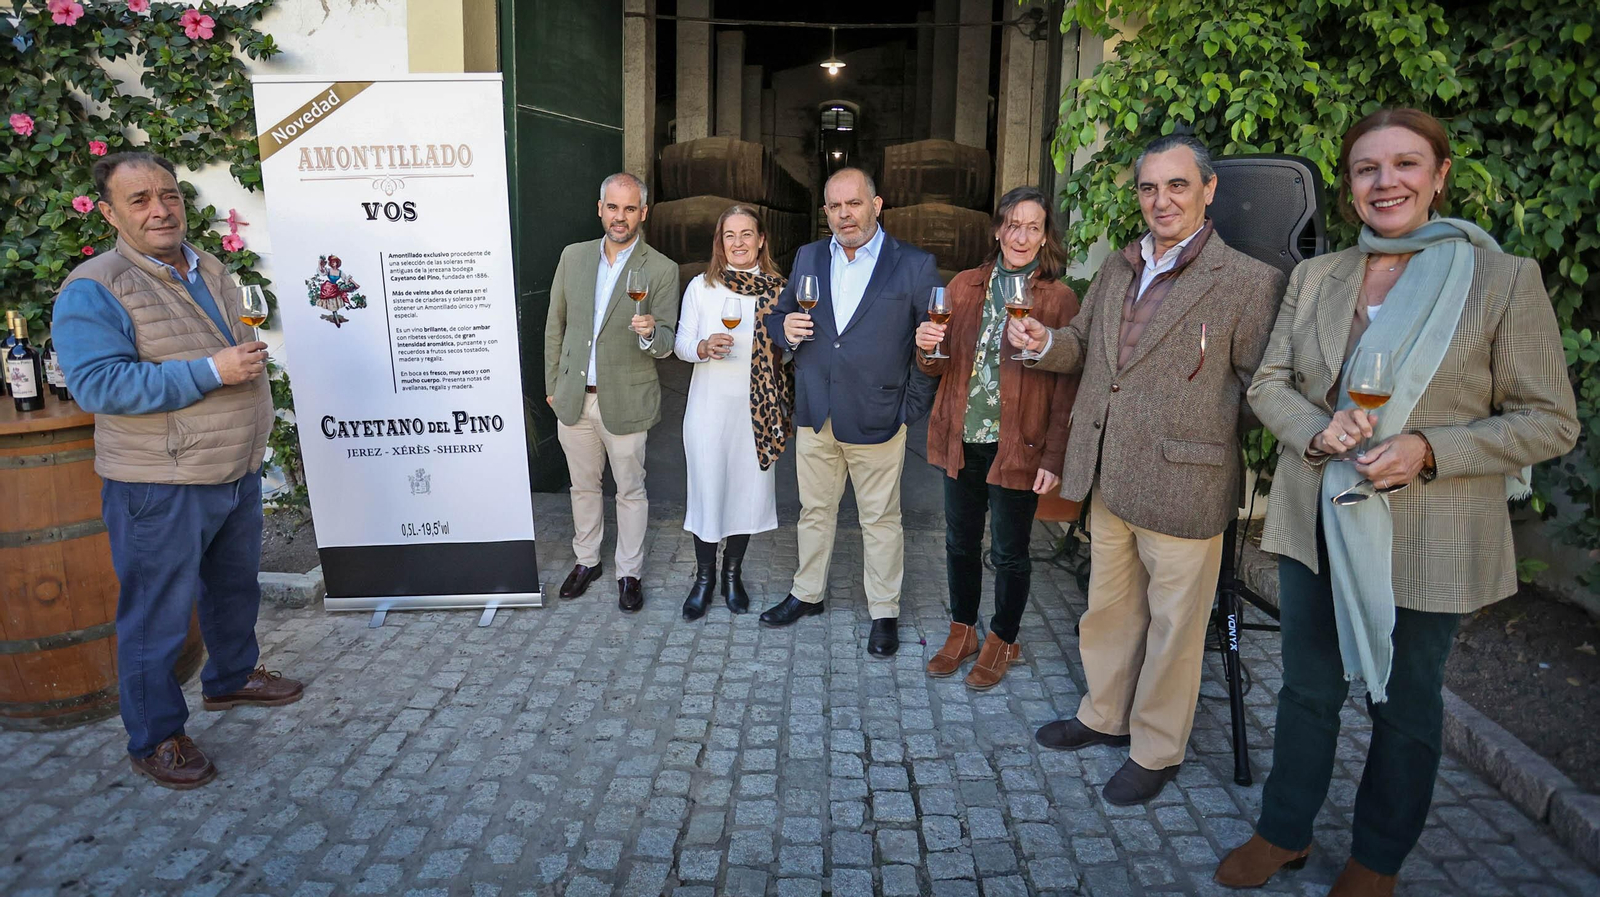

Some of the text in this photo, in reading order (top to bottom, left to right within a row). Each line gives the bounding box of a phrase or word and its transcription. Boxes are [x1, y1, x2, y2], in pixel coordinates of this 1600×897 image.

[271, 90, 341, 145] Novedad
[298, 144, 473, 171] AMONTILLADO
[361, 201, 418, 222] VOS
[321, 410, 504, 439] CAYETANO DEL PINO
[347, 448, 382, 458] JEREZ
[392, 444, 430, 456] XÉRÈS
[1228, 614, 1237, 651] VONYX
